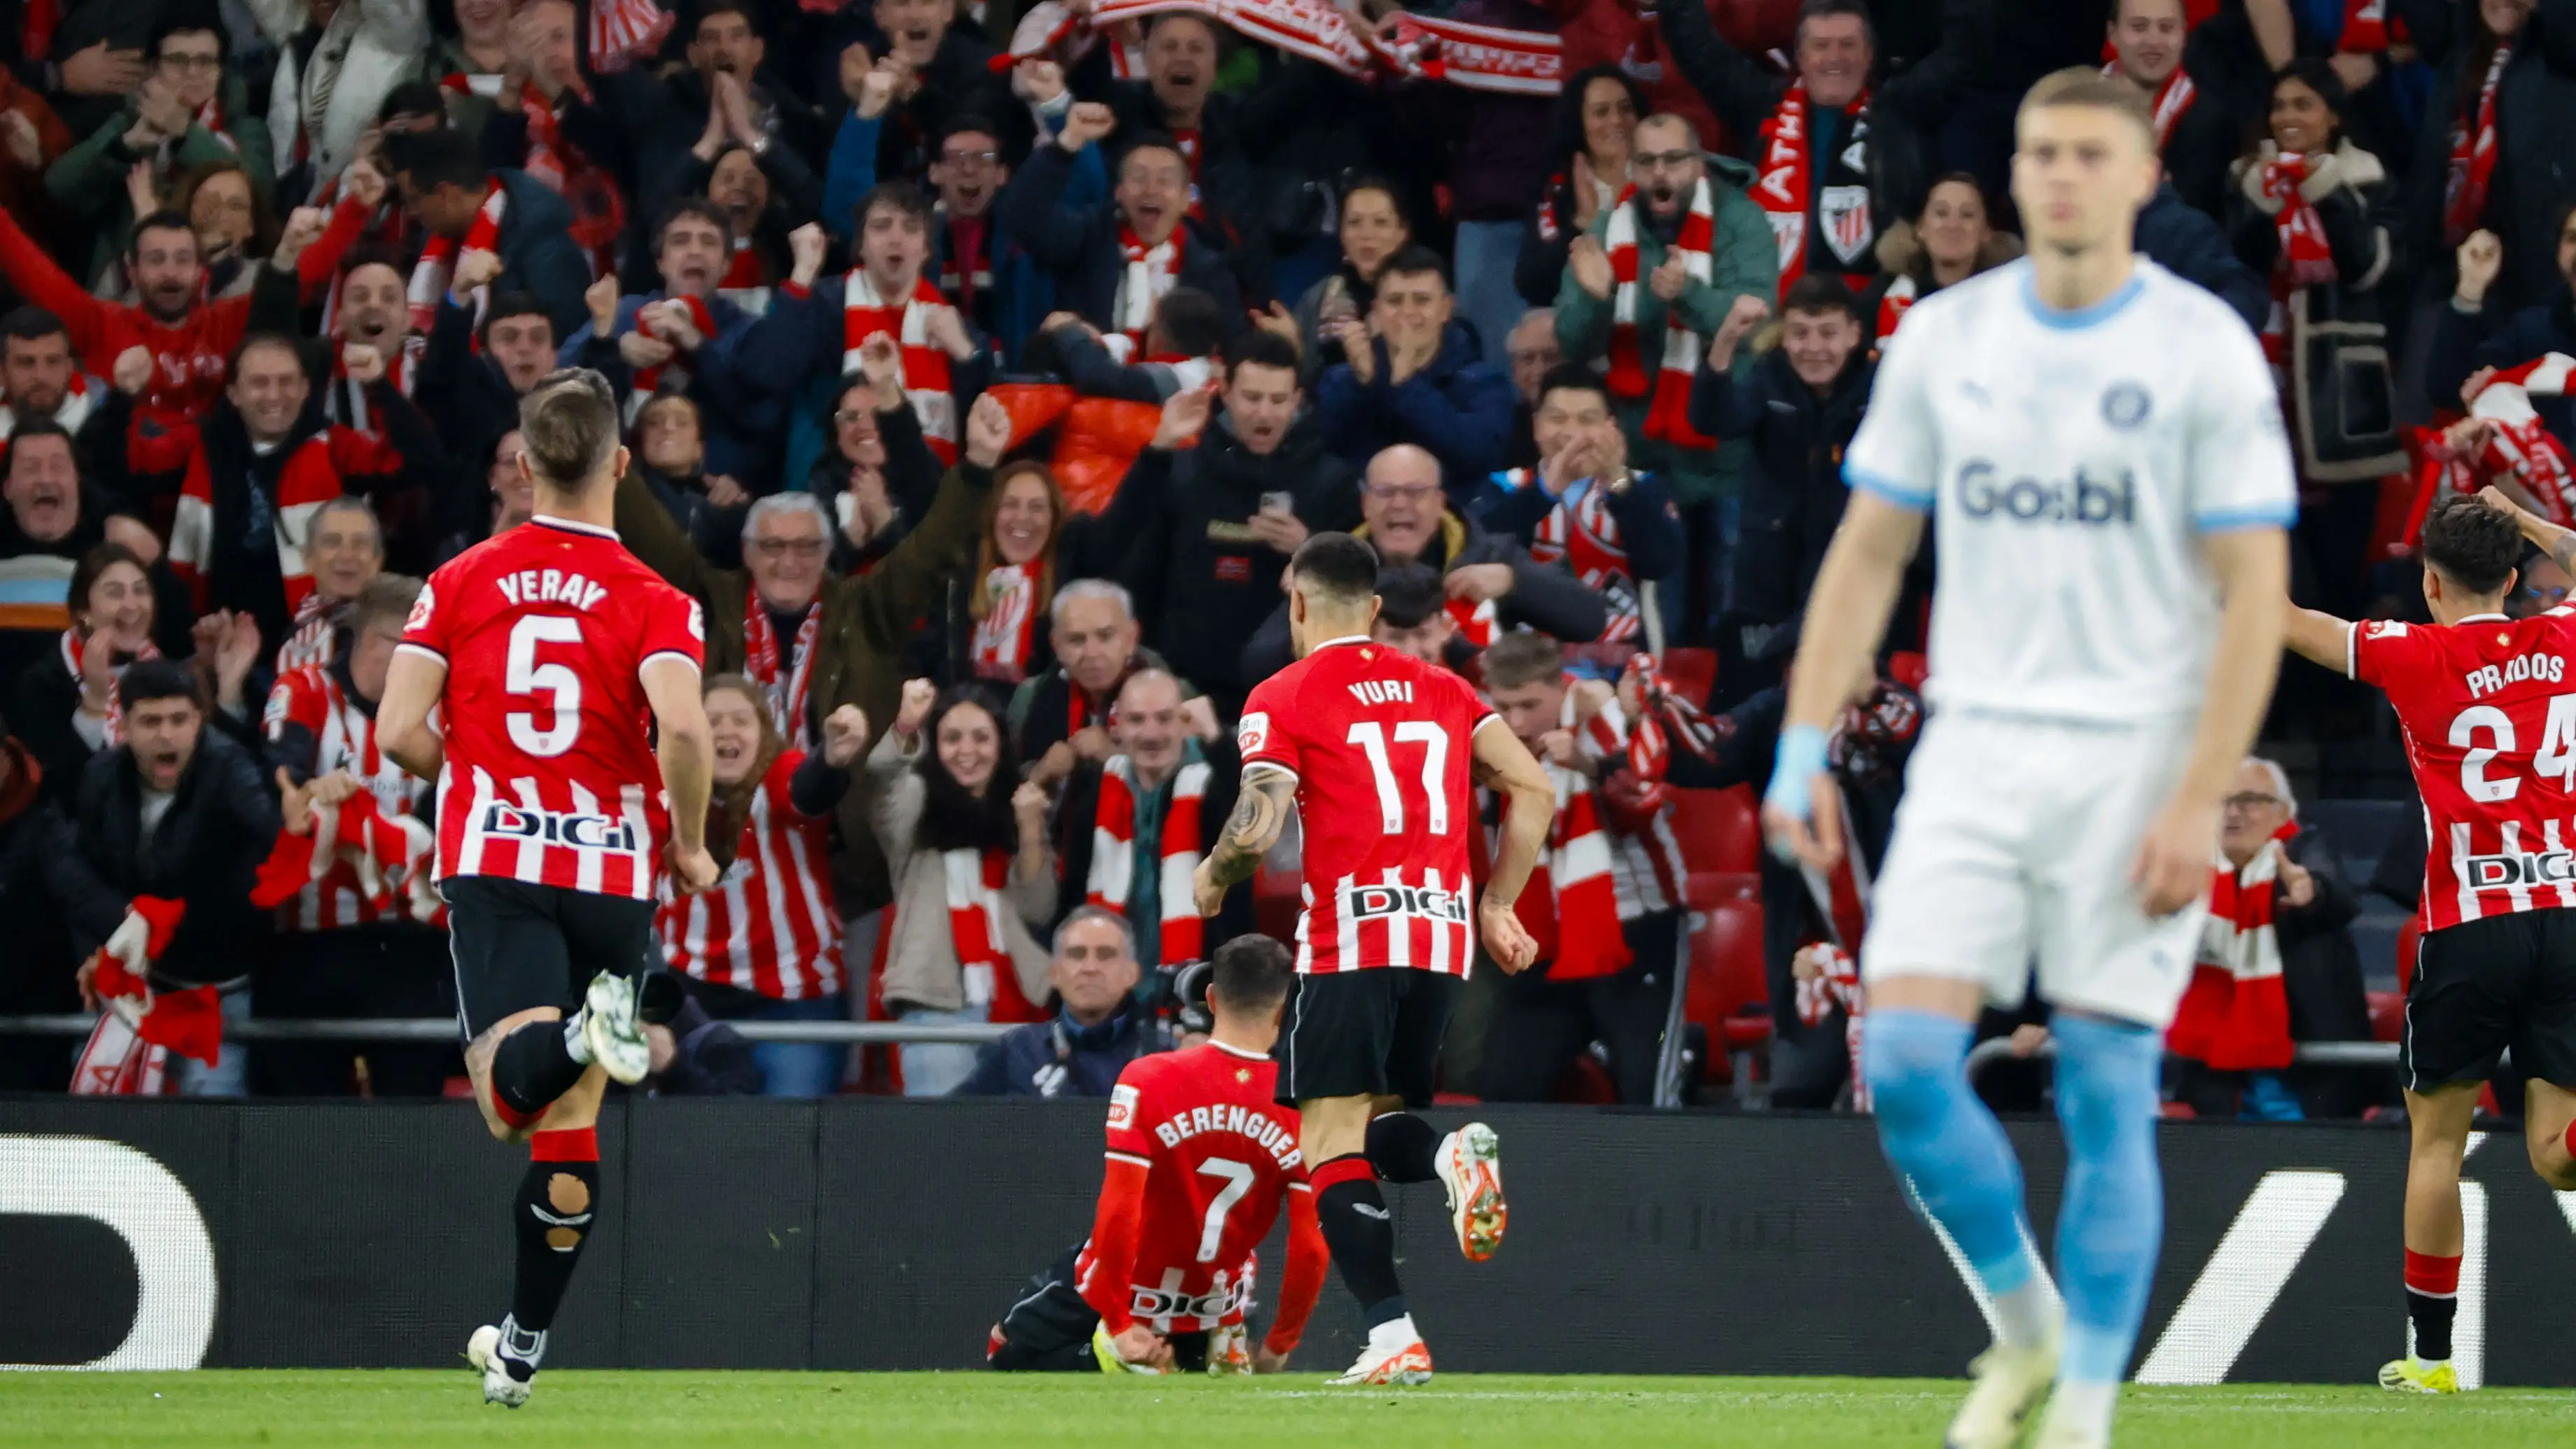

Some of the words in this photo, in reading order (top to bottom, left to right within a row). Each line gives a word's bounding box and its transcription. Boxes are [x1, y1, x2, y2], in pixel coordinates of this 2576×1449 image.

[496, 568, 608, 612] YERAY
[505, 613, 584, 758] 5
[1347, 680, 1413, 706] YURI
[2465, 652, 2566, 699] PRADOS
[2448, 692, 2576, 803] 24
[1346, 720, 1449, 835] 17
[481, 803, 638, 853] DIGI
[2467, 851, 2576, 888] DIG
[1350, 886, 1466, 922] DIGI
[1154, 1103, 1303, 1171] BERENGUER
[1196, 1156, 1256, 1264] 7
